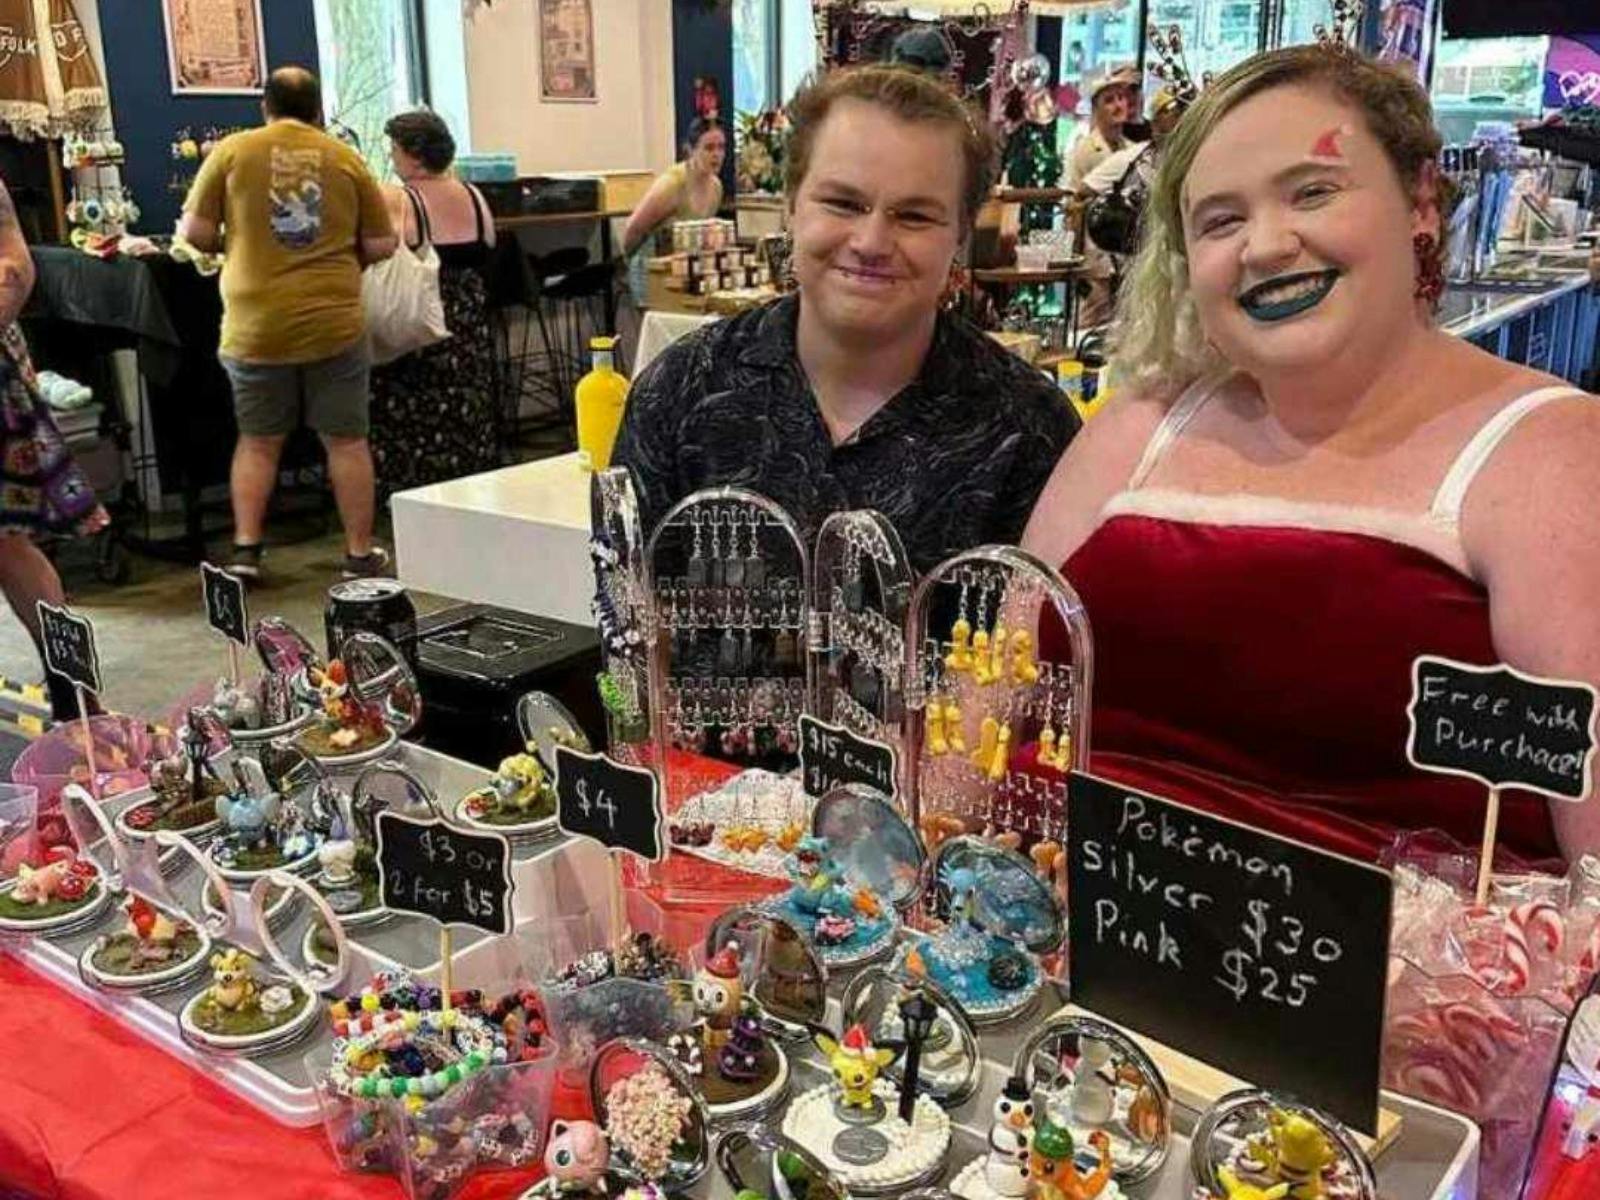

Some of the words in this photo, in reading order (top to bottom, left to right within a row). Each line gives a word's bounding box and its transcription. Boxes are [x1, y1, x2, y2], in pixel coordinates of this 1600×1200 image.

[1422, 675, 1511, 716] Free
[809, 726, 843, 759] $15
[575, 778, 619, 830] $4
[418, 830, 457, 863] $3
[389, 871, 405, 895] 2
[463, 879, 495, 917] $5
[1094, 898, 1184, 972] Pink
[1214, 947, 1318, 1008] $25
[1240, 898, 1343, 964] $30
